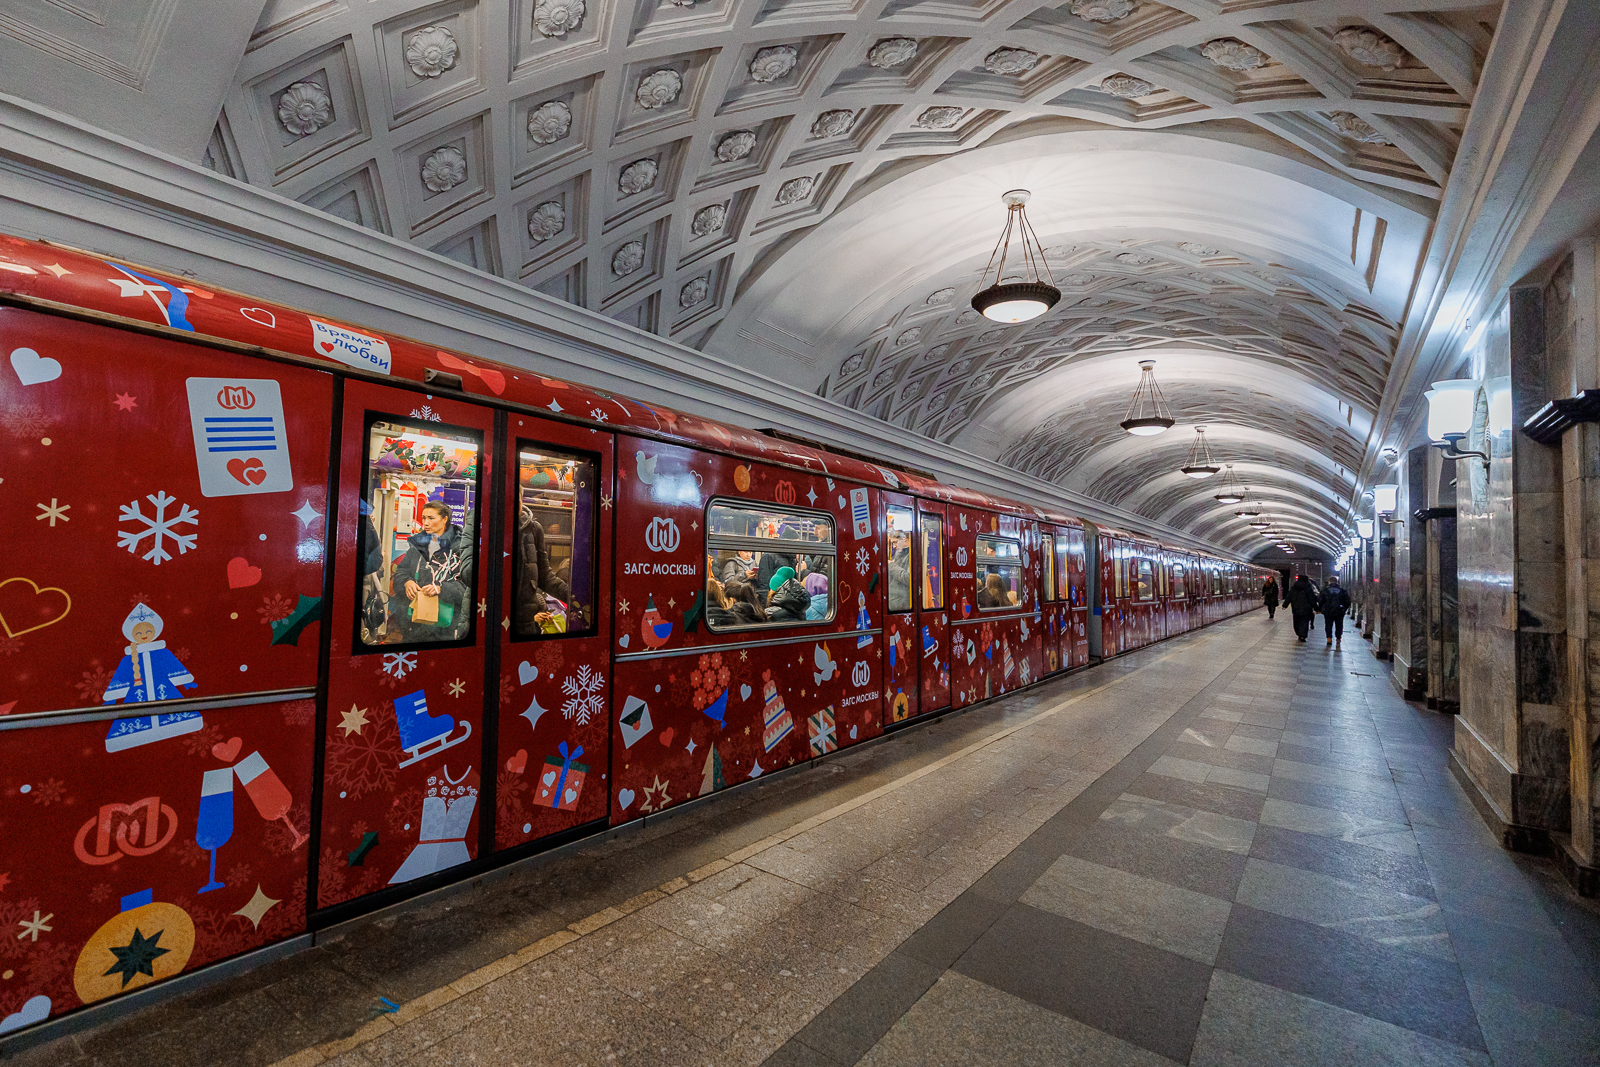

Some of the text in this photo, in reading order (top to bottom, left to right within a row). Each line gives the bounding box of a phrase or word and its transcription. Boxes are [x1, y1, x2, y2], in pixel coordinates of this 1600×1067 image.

[316, 323, 372, 346] Время
[333, 338, 389, 370] любви
[624, 562, 696, 575] ЗАГС МОСКВЫ
[841, 690, 879, 708] ЗАГС МОСКВЫ
